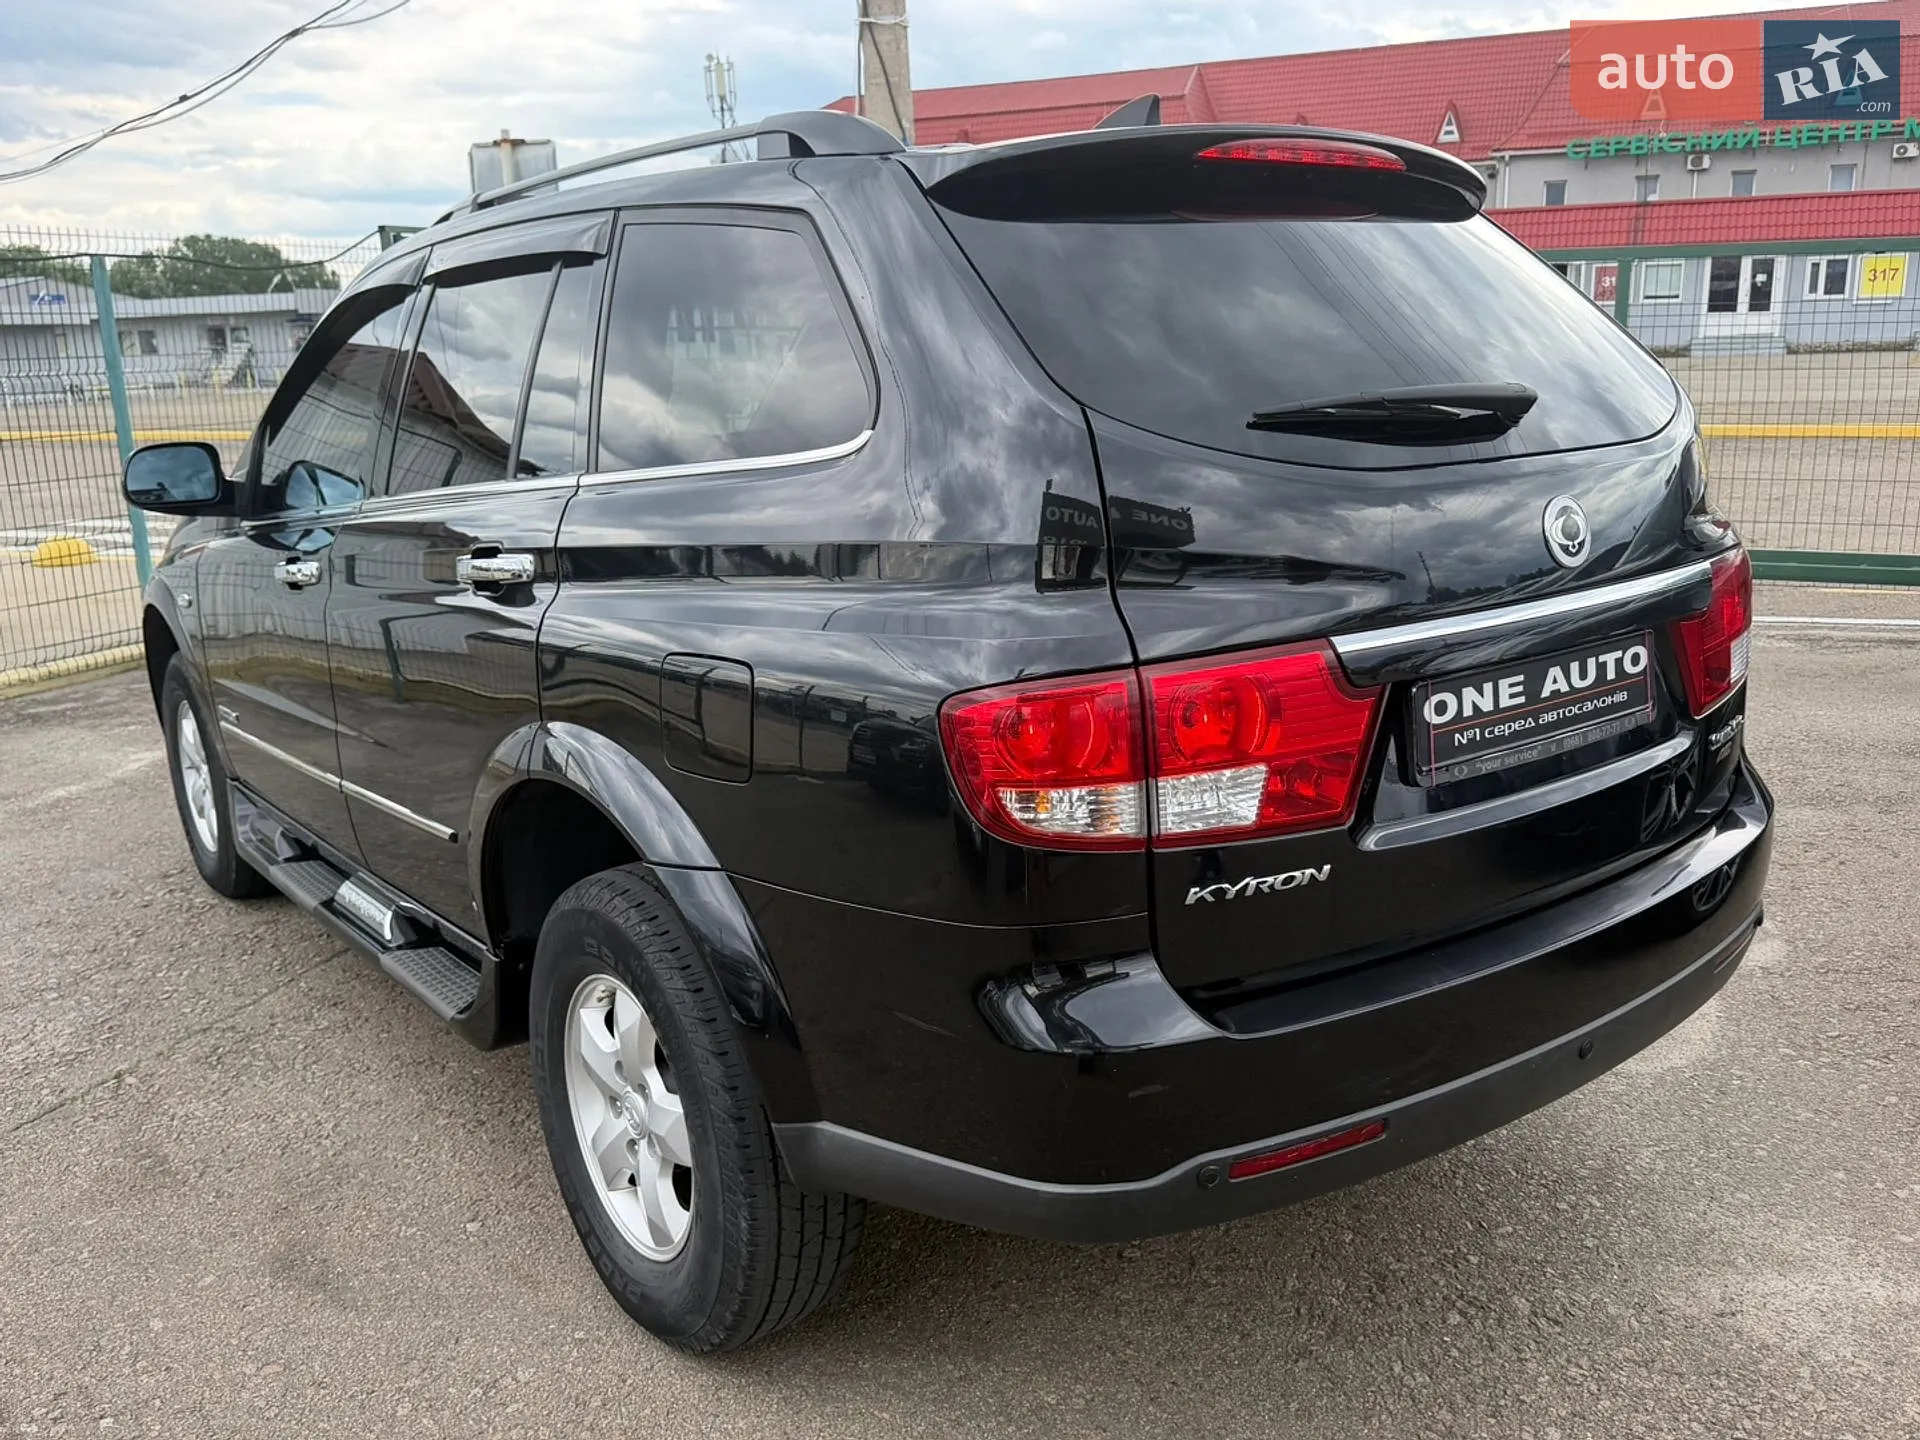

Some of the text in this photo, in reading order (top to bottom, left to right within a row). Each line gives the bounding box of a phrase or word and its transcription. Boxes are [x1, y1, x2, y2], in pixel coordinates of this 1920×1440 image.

[1775, 119, 1896, 149] ЦЕНТР
[1600, 276, 1617, 287] 31
[1867, 266, 1900, 283] 317
[1423, 645, 1649, 725] ONE AUTO
[1454, 727, 1481, 747] №1
[1484, 717, 1536, 739] серед
[1538, 690, 1629, 724] автосалонів
[1184, 863, 1331, 905] KYRON
